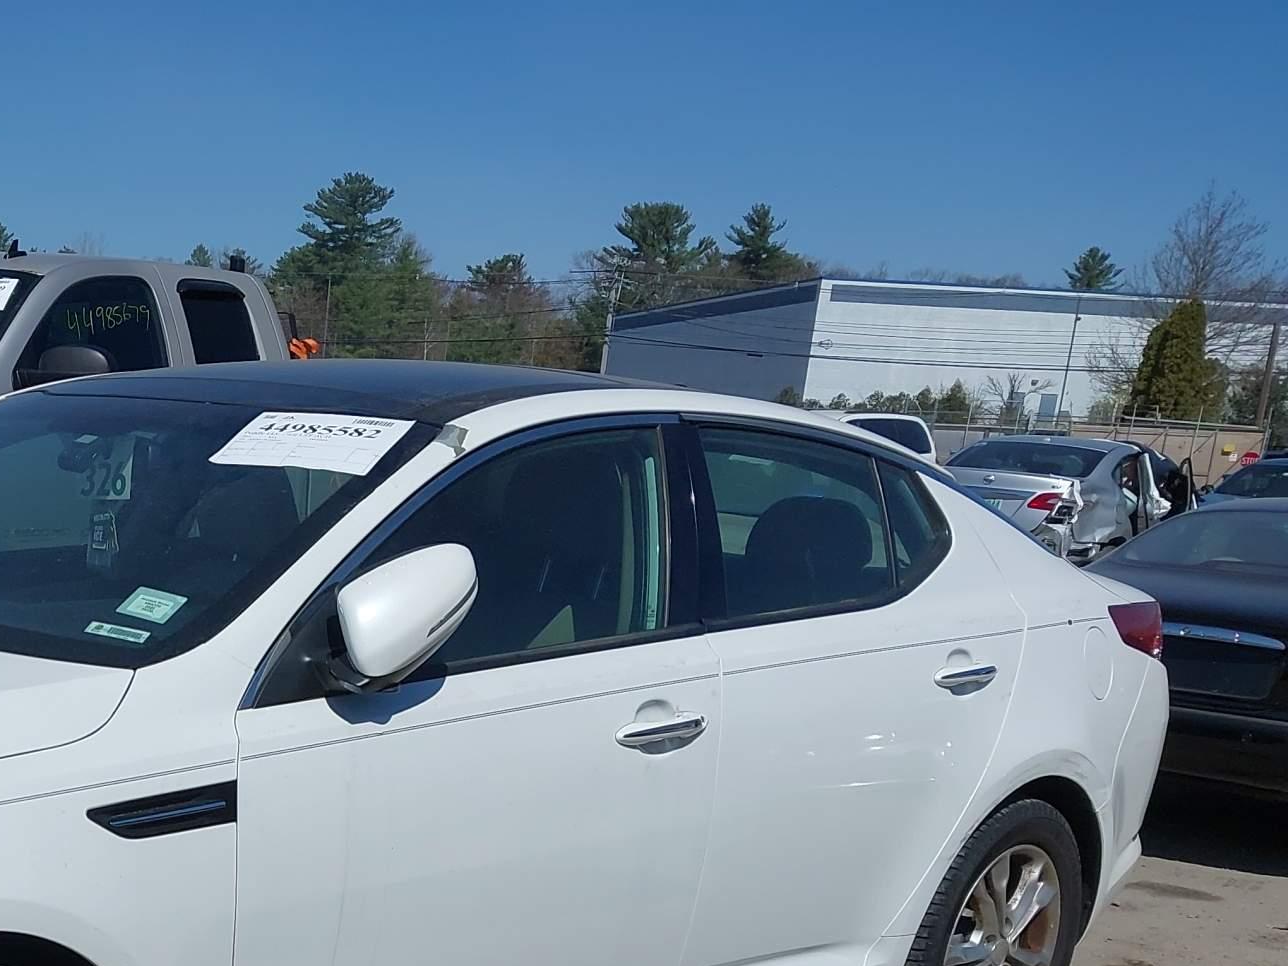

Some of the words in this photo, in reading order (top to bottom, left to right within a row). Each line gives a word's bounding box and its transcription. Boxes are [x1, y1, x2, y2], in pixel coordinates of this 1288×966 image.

[66, 302, 151, 340] 44985679
[258, 422, 382, 439] 44985582
[80, 461, 127, 497] 326
